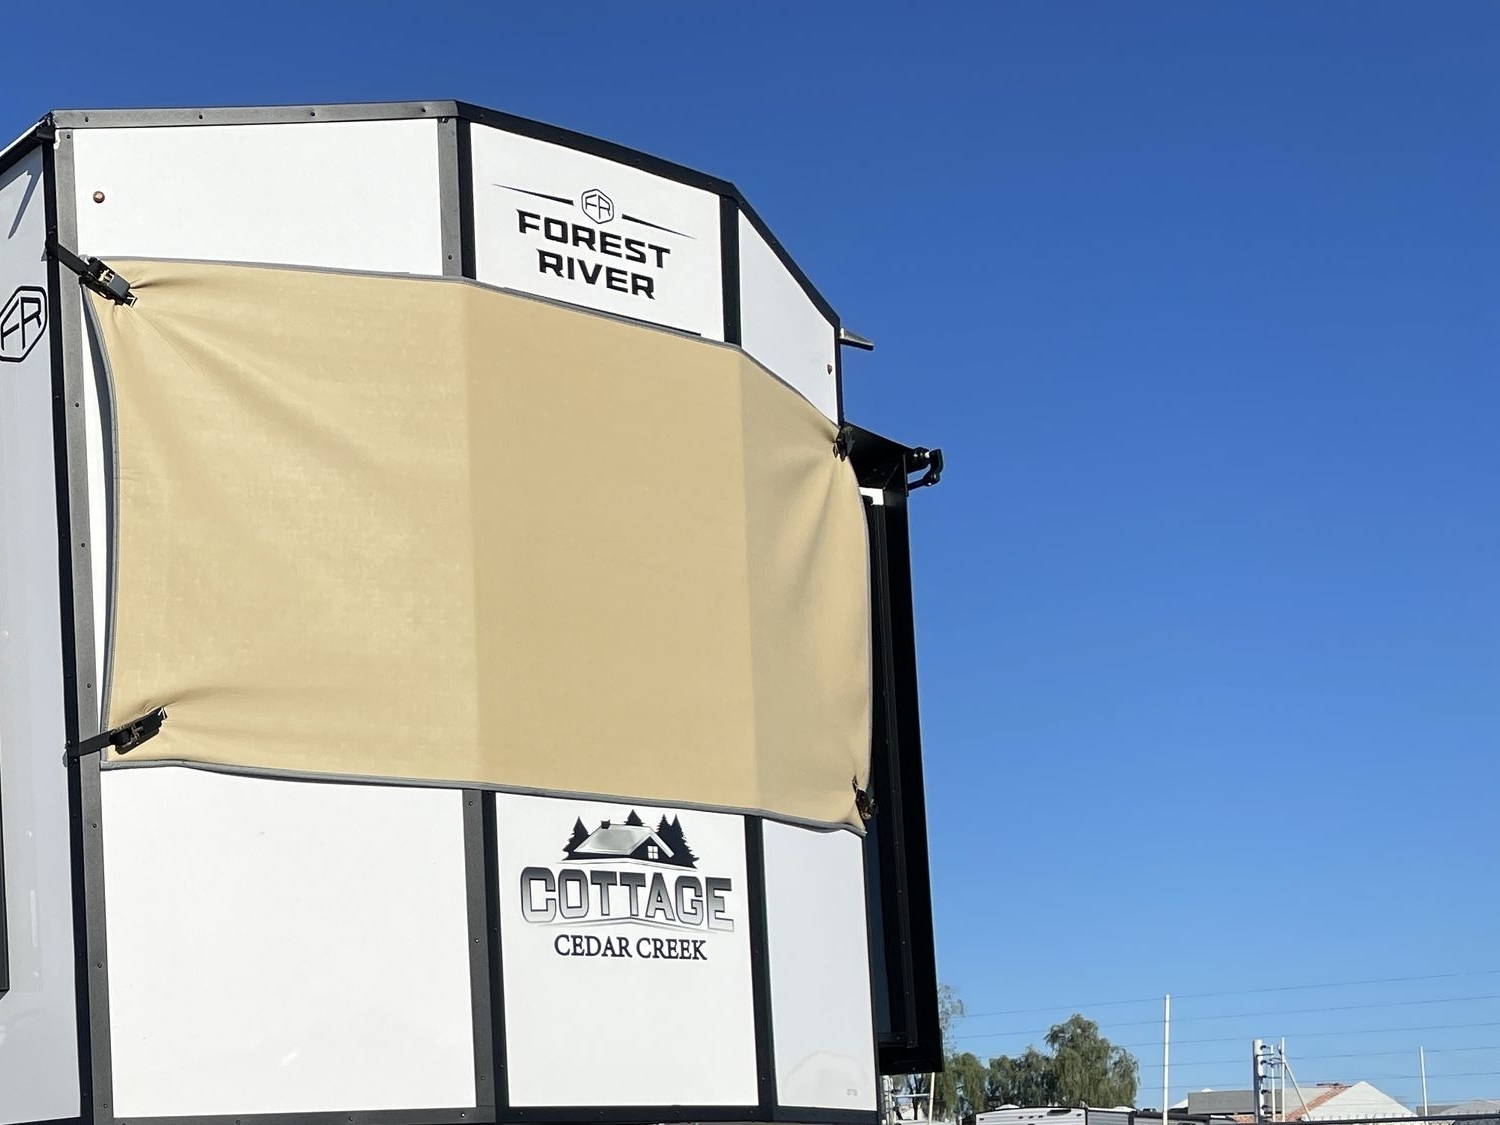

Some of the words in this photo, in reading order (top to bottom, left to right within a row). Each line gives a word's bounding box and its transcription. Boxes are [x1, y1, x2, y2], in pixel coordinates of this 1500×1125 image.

[516, 208, 671, 269] FOREST
[536, 248, 656, 300] RIVER
[520, 866, 735, 932] COTTAGE
[554, 934, 633, 958] CEDAR
[636, 937, 708, 960] CREEK
